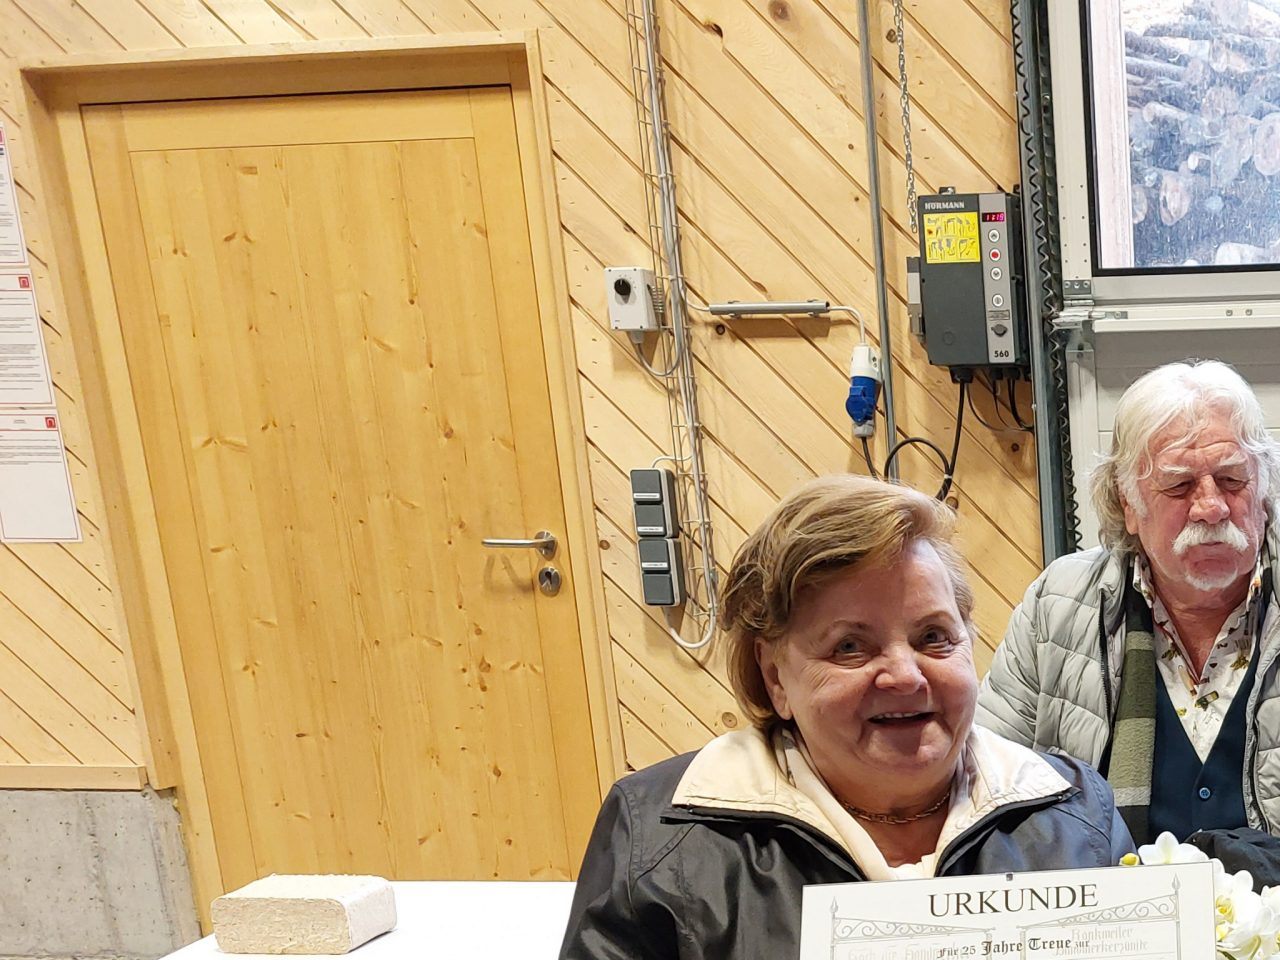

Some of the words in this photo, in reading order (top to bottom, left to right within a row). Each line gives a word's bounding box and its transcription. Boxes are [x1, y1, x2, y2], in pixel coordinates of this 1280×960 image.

[994, 350, 1010, 358] 560
[928, 883, 1099, 918] URKUNDE
[962, 945, 976, 956] 25
[981, 939, 1023, 956] Jahre
[1028, 937, 1072, 951] Treue
[1075, 940, 1090, 949] zur
